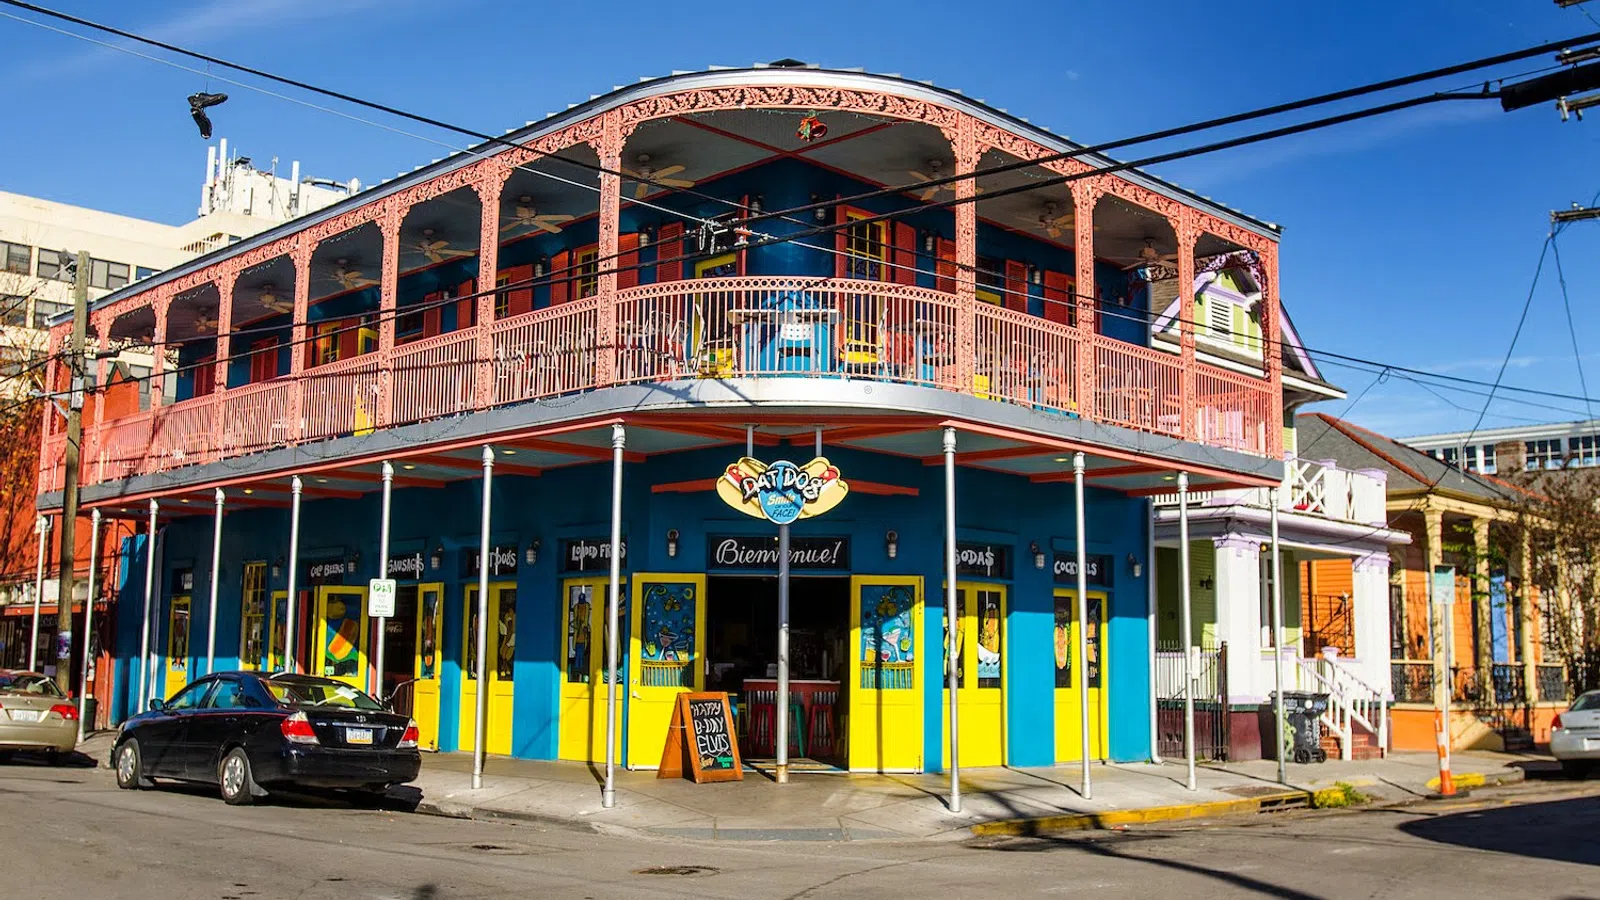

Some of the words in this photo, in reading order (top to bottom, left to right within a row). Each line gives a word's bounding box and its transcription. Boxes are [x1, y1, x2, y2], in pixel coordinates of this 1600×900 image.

[742, 469, 779, 500] DAT
[767, 493, 796, 506] Smile
[771, 508, 796, 518] FACE!
[599, 541, 626, 560] FRS
[716, 539, 842, 565] Bienvnue!
[323, 563, 344, 577] BEERS
[691, 702, 722, 717] HAPPY
[694, 716, 724, 735] B-DAY
[697, 733, 729, 755] ELVIS
